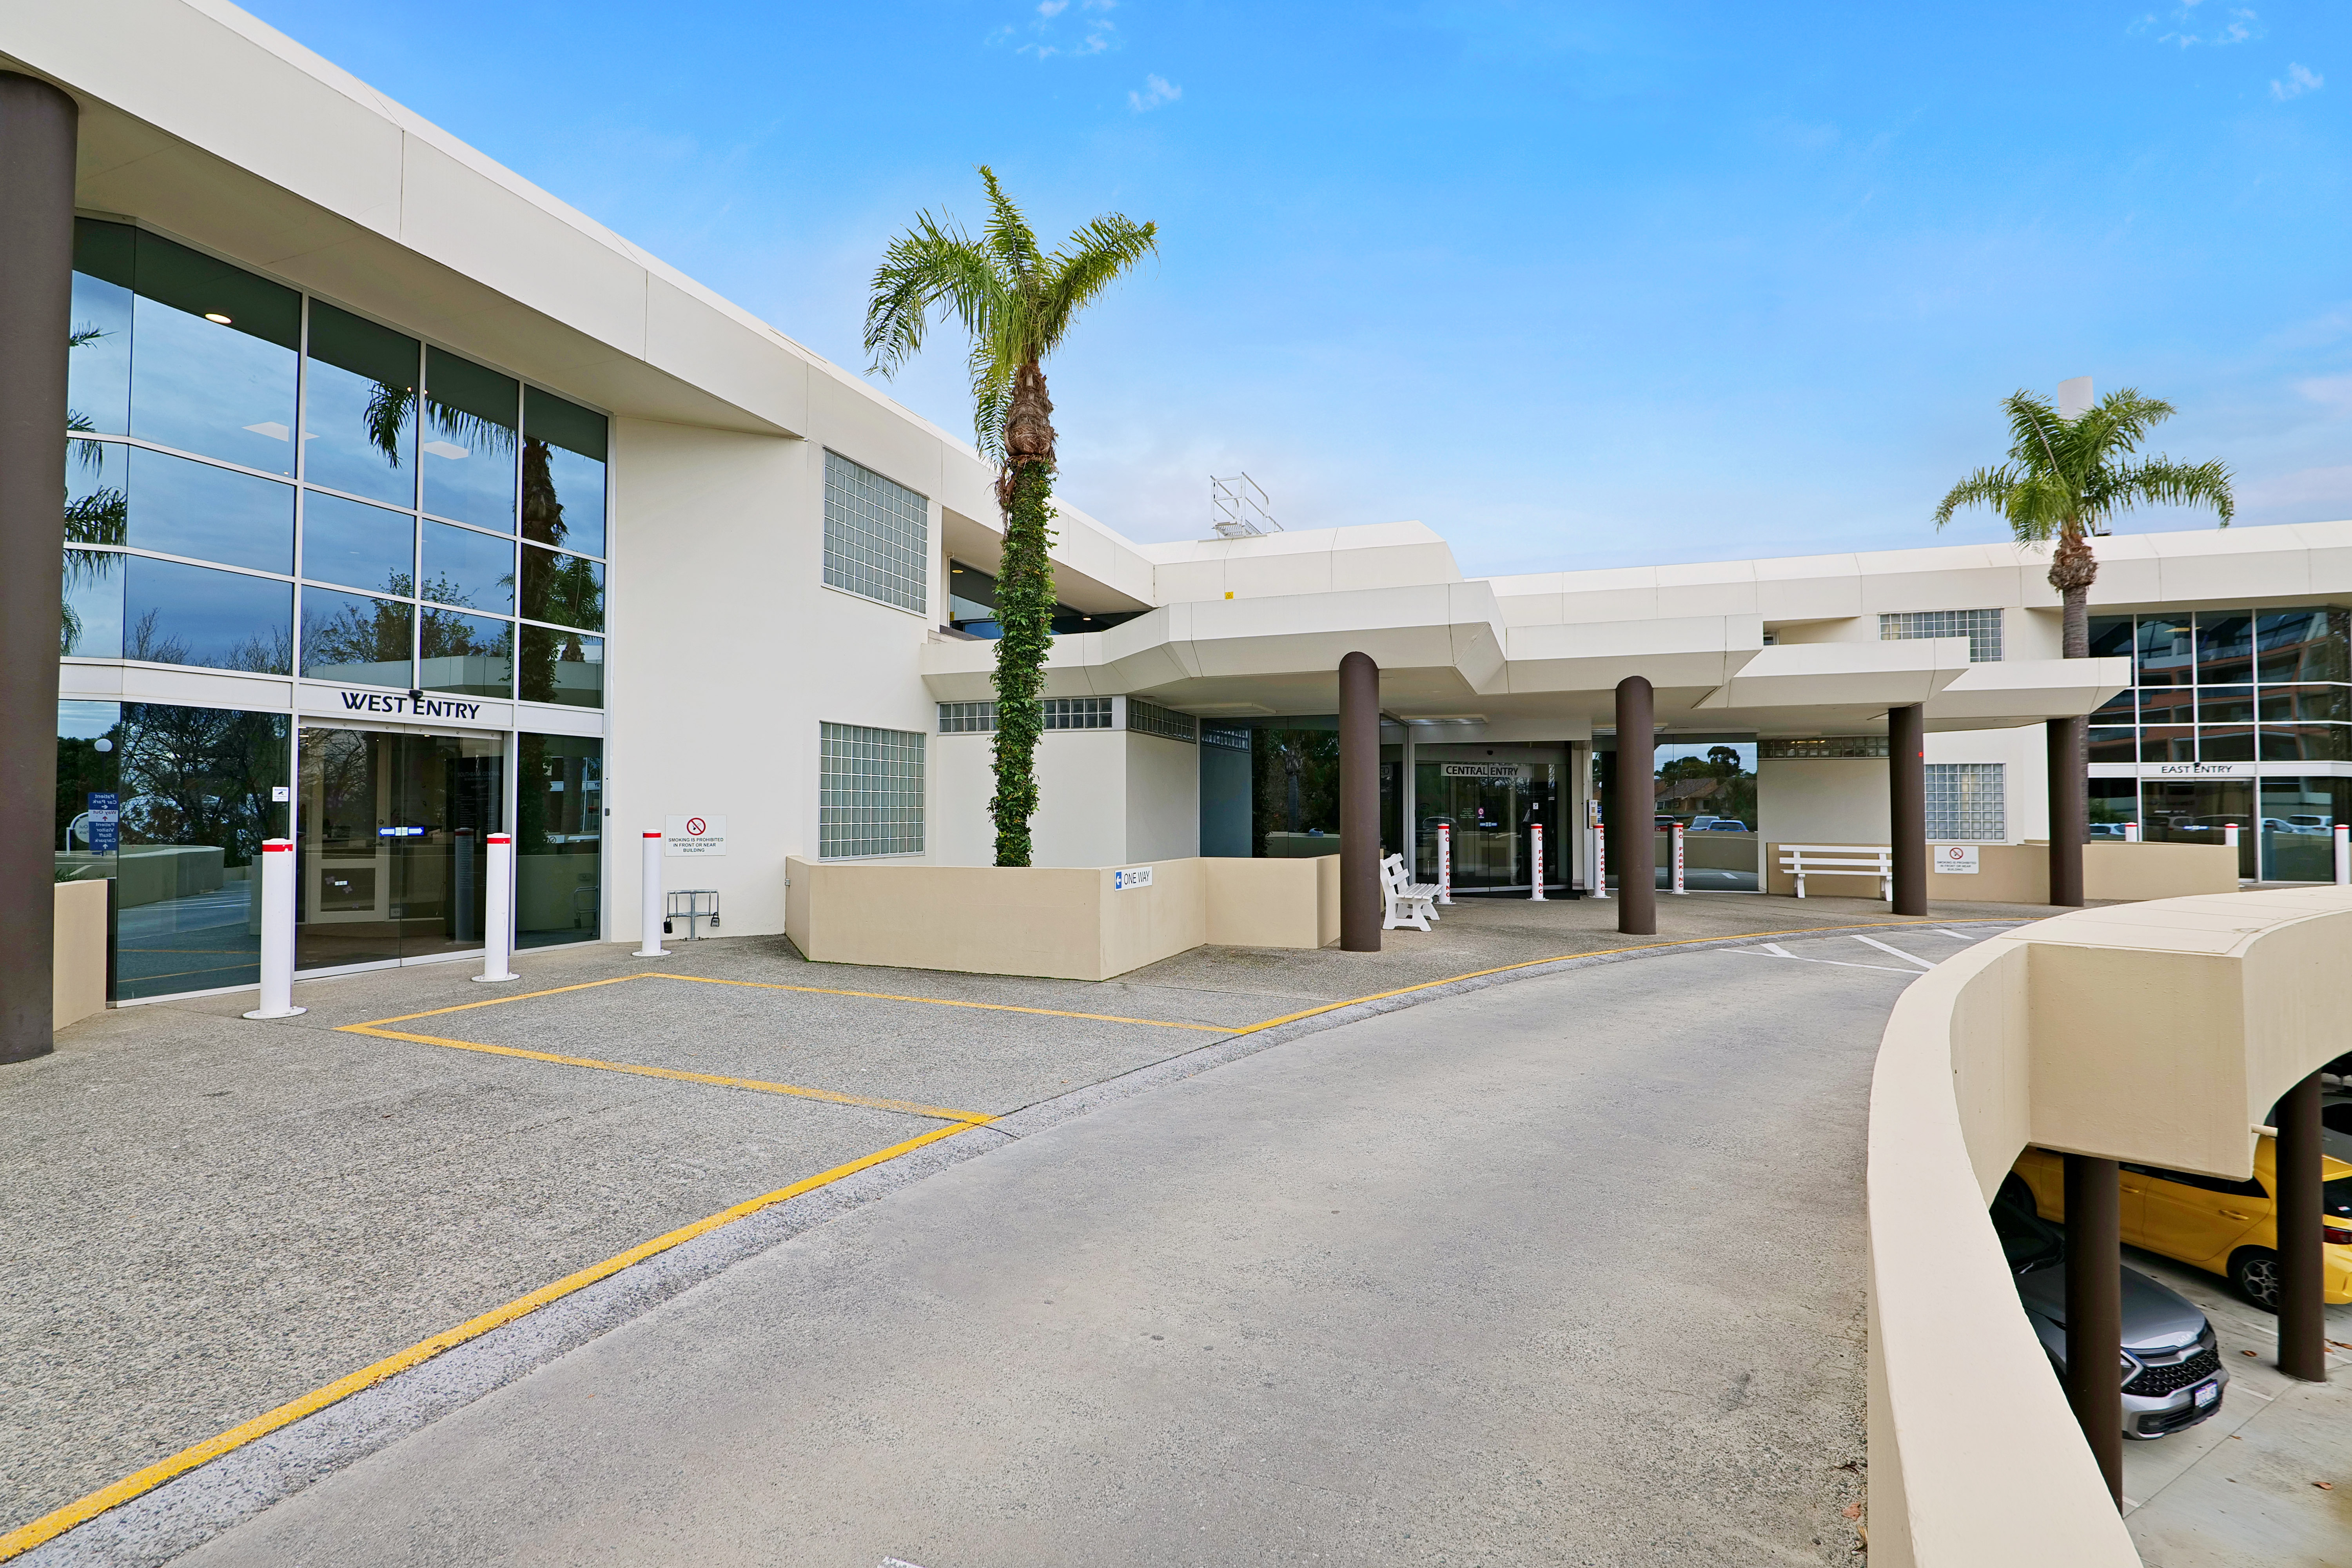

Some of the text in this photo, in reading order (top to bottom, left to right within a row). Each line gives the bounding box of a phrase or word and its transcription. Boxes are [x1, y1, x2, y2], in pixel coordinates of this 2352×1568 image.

[341, 692, 480, 719] WEST ENTRY
[1446, 766, 1518, 776] CENTRAL ENTRY
[1445, 830, 1450, 842] NO
[1538, 830, 1543, 841] NO
[1600, 829, 1604, 840] NO
[1679, 828, 1683, 839] NO
[1124, 870, 1150, 885] ONE WAY
